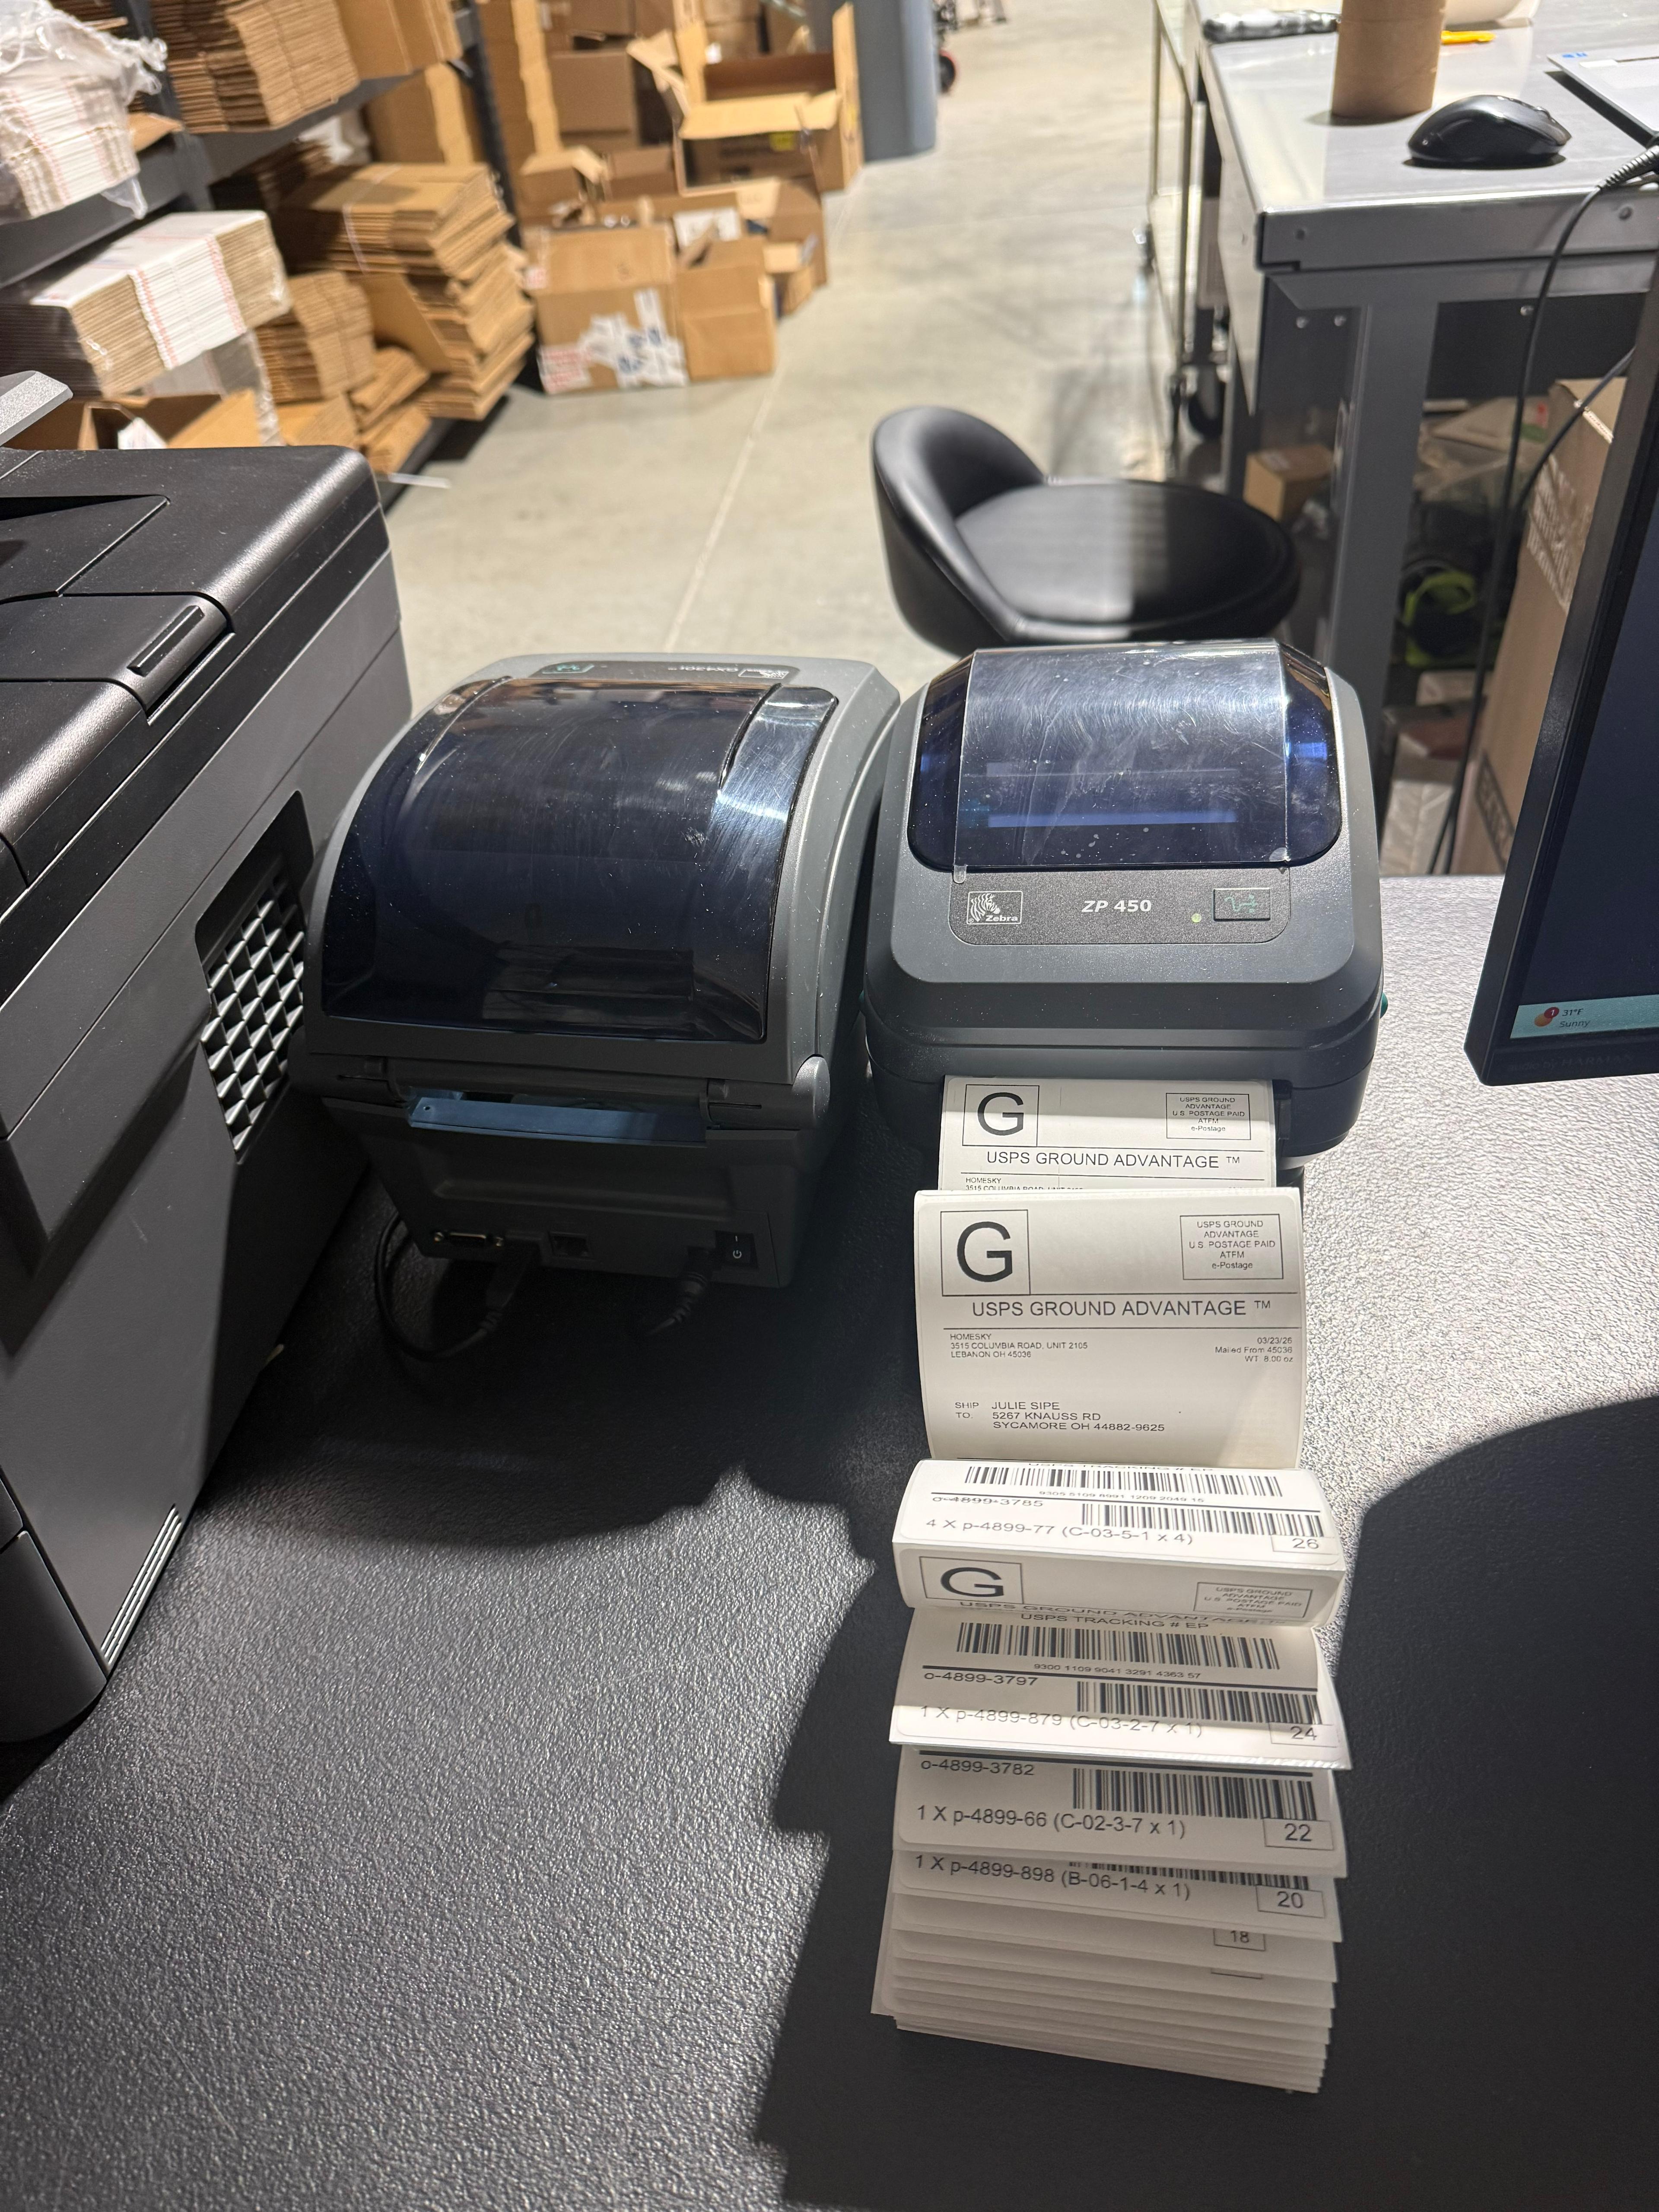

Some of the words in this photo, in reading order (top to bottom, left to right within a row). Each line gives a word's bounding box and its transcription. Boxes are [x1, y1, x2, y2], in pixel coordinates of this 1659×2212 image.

[1081, 901, 1109, 912] ZP
[1114, 900, 1151, 912] 450
[977, 1092, 1024, 1135] G
[986, 1151, 1030, 1164] USPS
[1036, 1153, 1108, 1166] GROUND
[1114, 1154, 1219, 1168] ADVANTAGE
[957, 1221, 1013, 1282] G
[1212, 1262, 1253, 1270] e-Postage
[972, 1302, 1023, 1316] USPS
[1030, 1301, 1116, 1316] GROUND
[1122, 1300, 1246, 1316] ADVANTAGE
[1094, 1424, 1164, 1432] 44882-9625
[933, 1497, 1043, 1507] o-4899-3785
[943, 1520, 956, 1528] X
[963, 1522, 1055, 1534] p-4899-77
[1062, 1526, 1149, 1542] (C-03-5-1
[1158, 1534, 1167, 1542] x
[1174, 1532, 1192, 1545] 4)
[1291, 1538, 1319, 1550] 26
[941, 1567, 1004, 1599] G
[1023, 1605, 1117, 1615] GROUND
[1072, 1617, 1164, 1627] TRACKING
[924, 1672, 1038, 1687] o-4899-3797
[920, 1706, 927, 1718] 1
[935, 1707, 950, 1719] X
[957, 1709, 1062, 1726] p-4899-879
[1070, 1714, 1159, 1733] (C-03-2-7
[1167, 1724, 1177, 1734] x
[1185, 1724, 1202, 1738] 1)
[1290, 1726, 1317, 1740] 24
[921, 1759, 1035, 1775] o-4899-3782
[918, 1805, 925, 1820] 1
[933, 1806, 947, 1821] X
[953, 1808, 1046, 1826] p-4899-66
[1053, 1813, 1142, 1835] (C-02-3-7
[1150, 1821, 1160, 1834] x
[1167, 1820, 1185, 1840] 1)
[1284, 1824, 1313, 1842] 22
[916, 1855, 922, 1868] 1
[931, 1857, 944, 1870] X
[951, 1861, 1054, 1882] p-4899-898
[1061, 1870, 1148, 1895] (B-06-1-4
[1155, 1883, 1165, 1895] x
[1173, 1882, 1190, 1901] 1)
[1277, 1891, 1303, 1909] 20
[1231, 1930, 1249, 1943] 18
